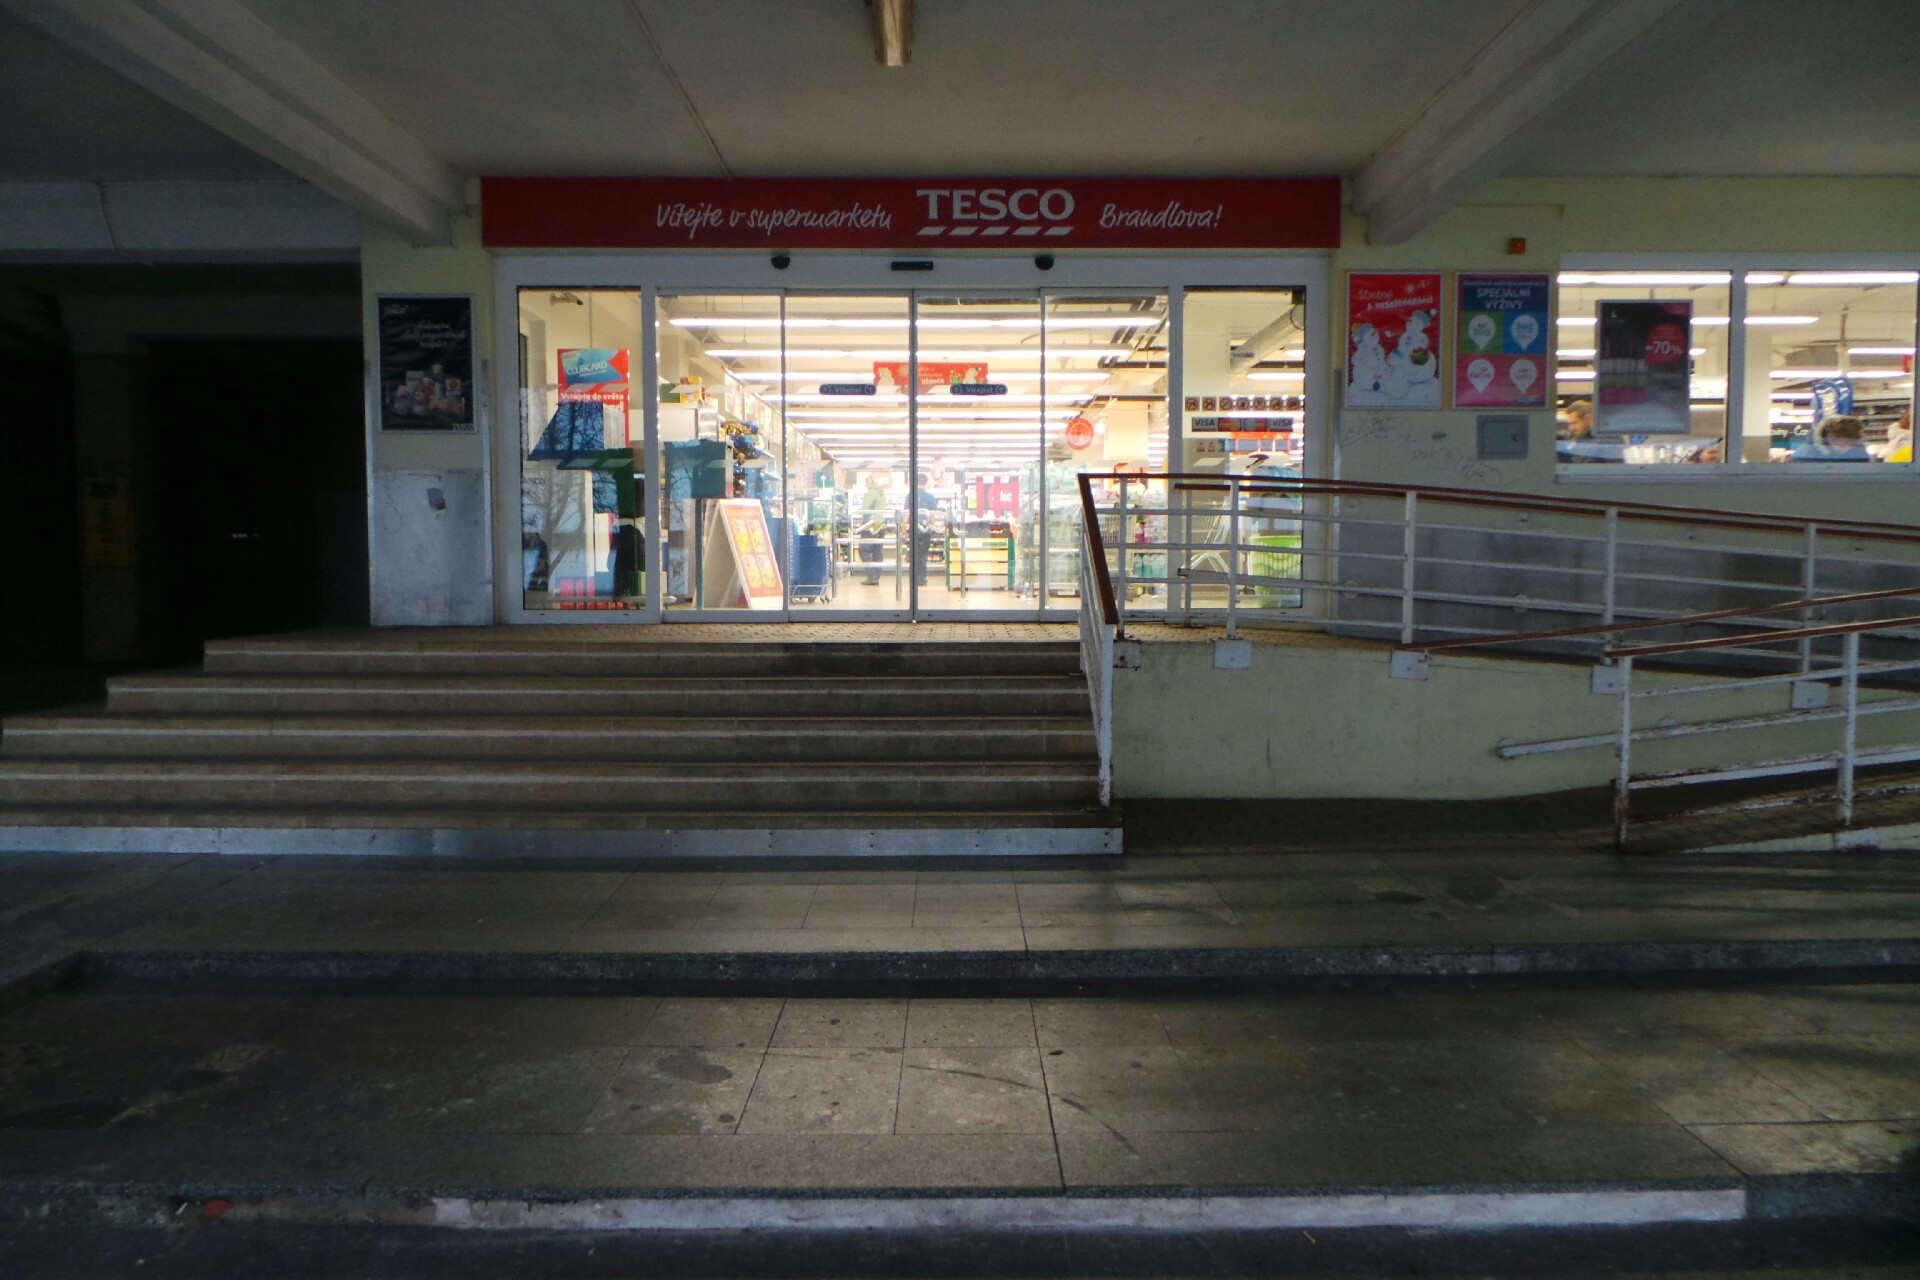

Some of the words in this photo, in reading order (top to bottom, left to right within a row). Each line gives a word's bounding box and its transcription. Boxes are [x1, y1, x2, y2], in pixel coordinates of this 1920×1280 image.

[916, 188, 1075, 221] TESCO
[656, 202, 724, 240] Vítejte
[729, 211, 746, 228] v
[747, 202, 893, 236] supermarketu
[566, 361, 608, 375] CLUBCARD
[1194, 418, 1216, 426] VISA
[1272, 418, 1294, 426] VISA
